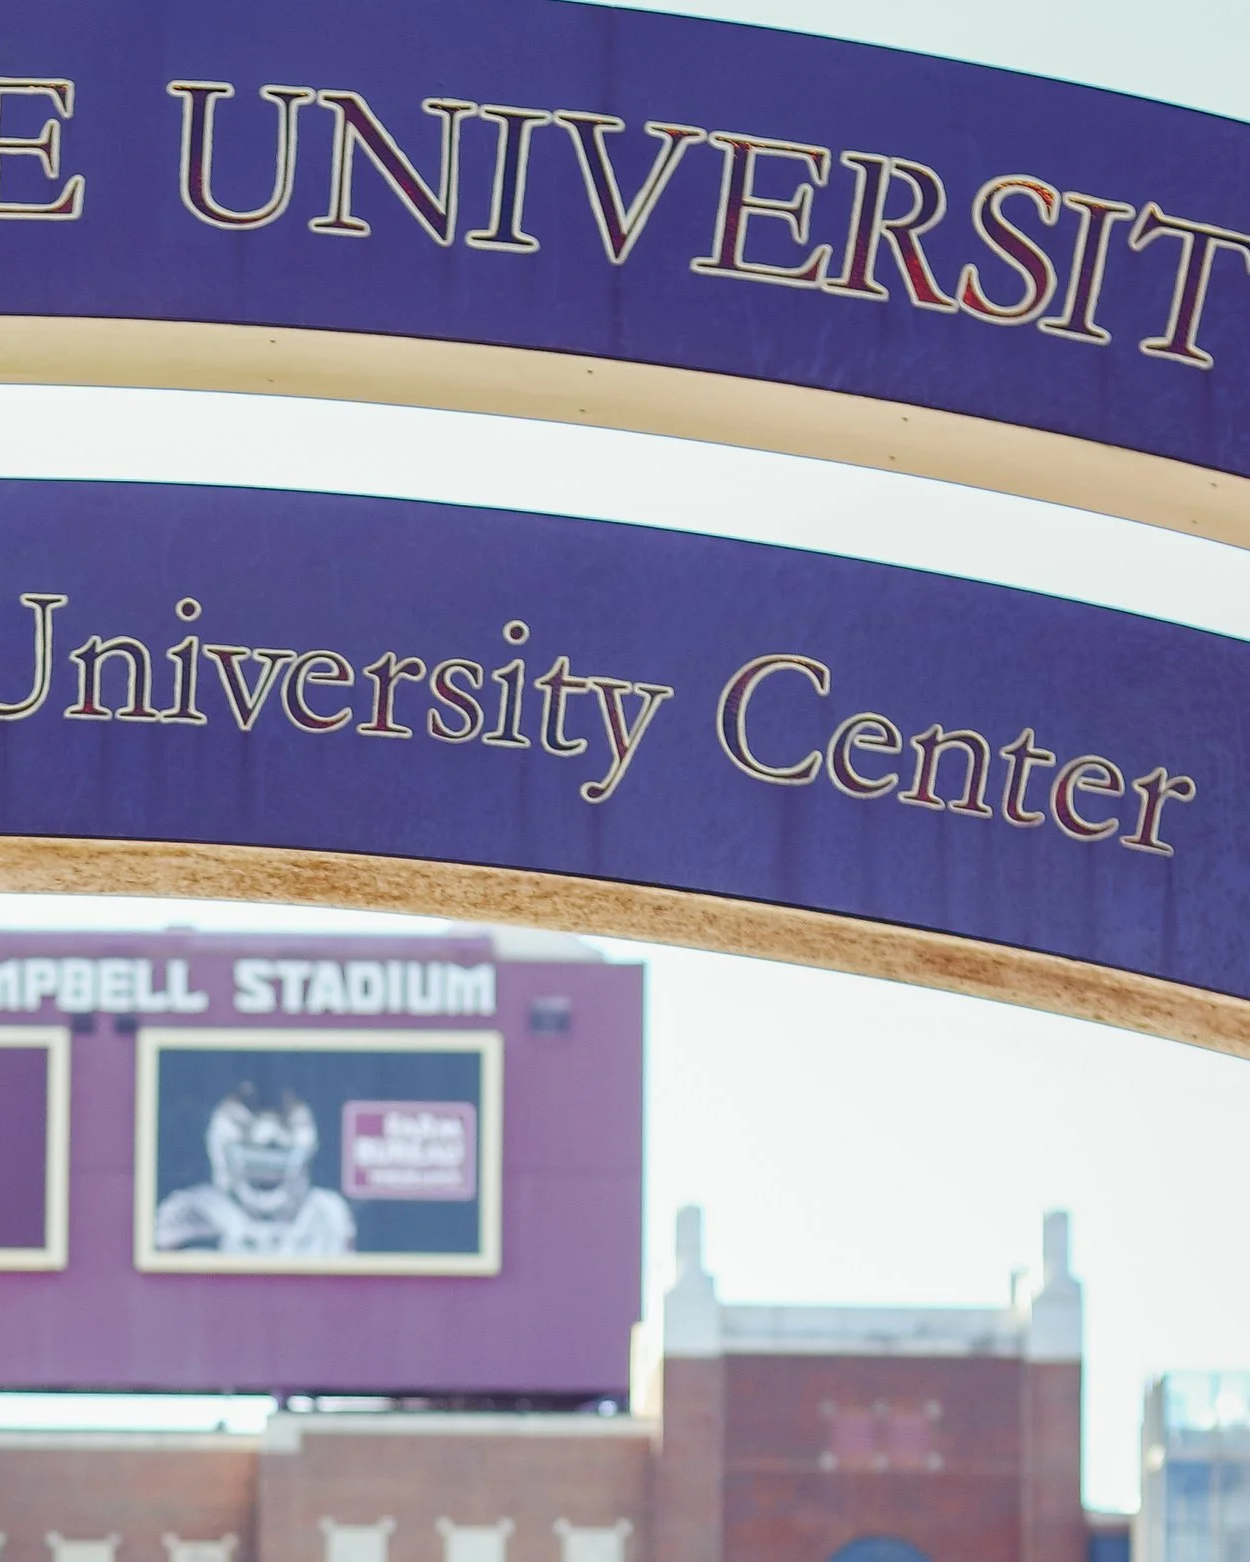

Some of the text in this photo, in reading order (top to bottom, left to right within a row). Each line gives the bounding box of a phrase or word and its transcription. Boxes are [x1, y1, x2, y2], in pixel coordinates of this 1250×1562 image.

[167, 80, 1250, 369] UNIVERSIT
[717, 655, 1196, 856] Center
[234, 959, 496, 1015] STADIUM
